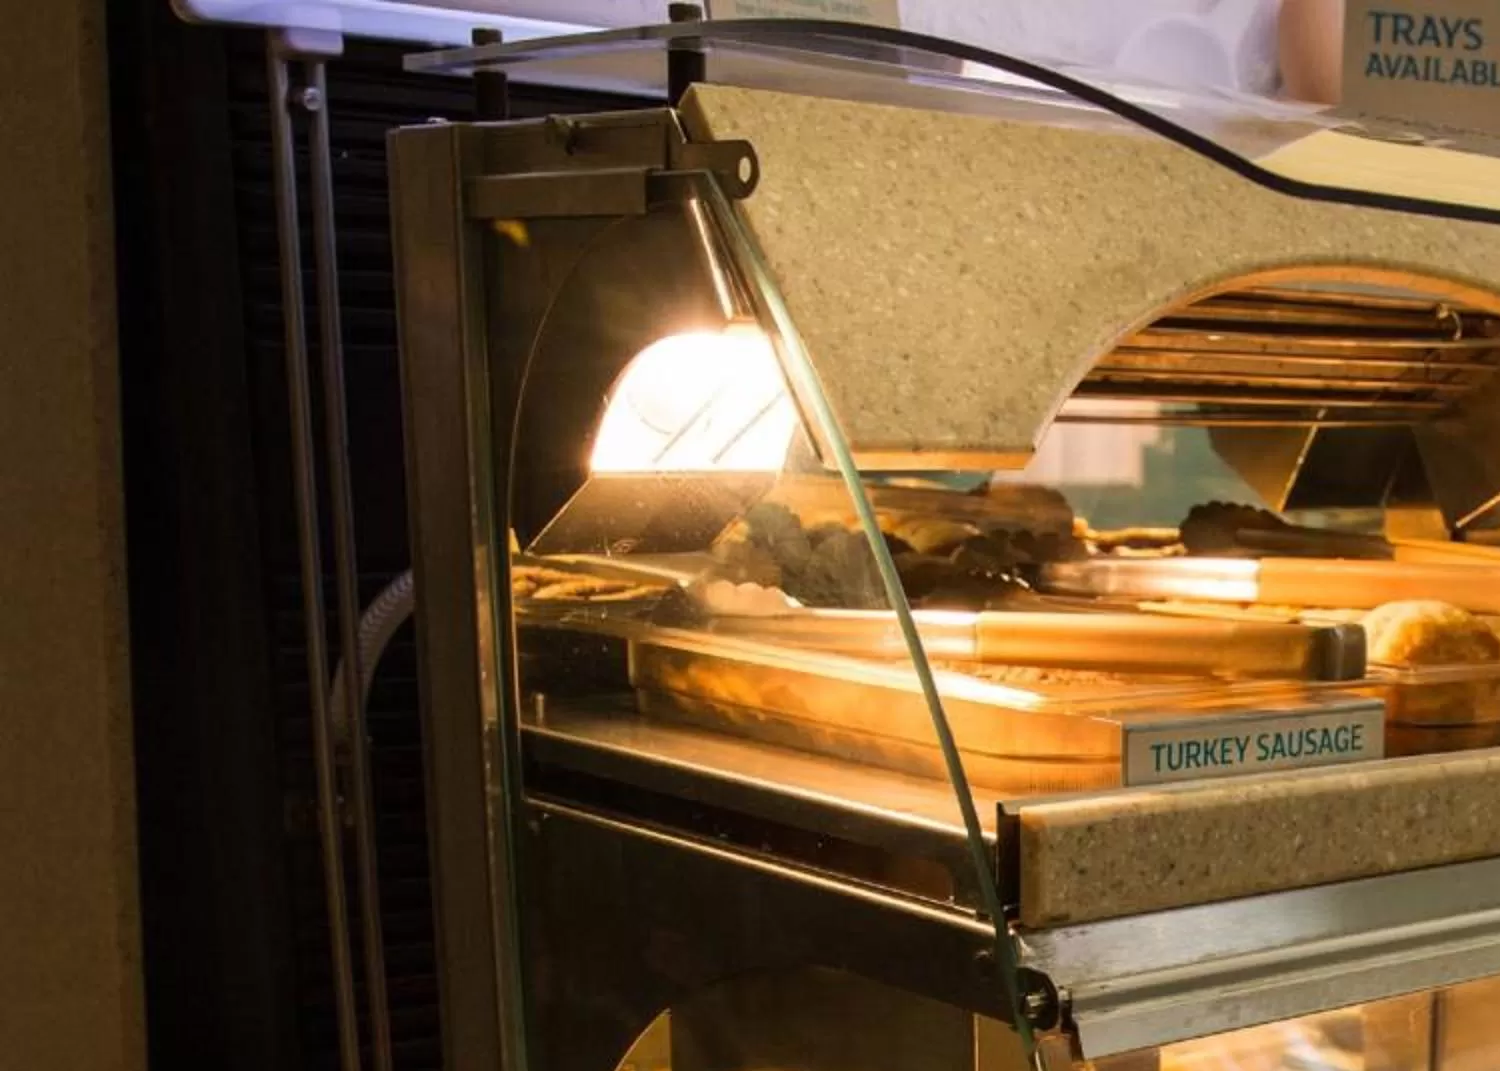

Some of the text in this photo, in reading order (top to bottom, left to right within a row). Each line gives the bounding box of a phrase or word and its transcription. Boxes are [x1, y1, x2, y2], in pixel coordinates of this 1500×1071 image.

[1368, 11, 1483, 50] TRAYS
[1151, 724, 1365, 773] TURKEY SAUSAGE
